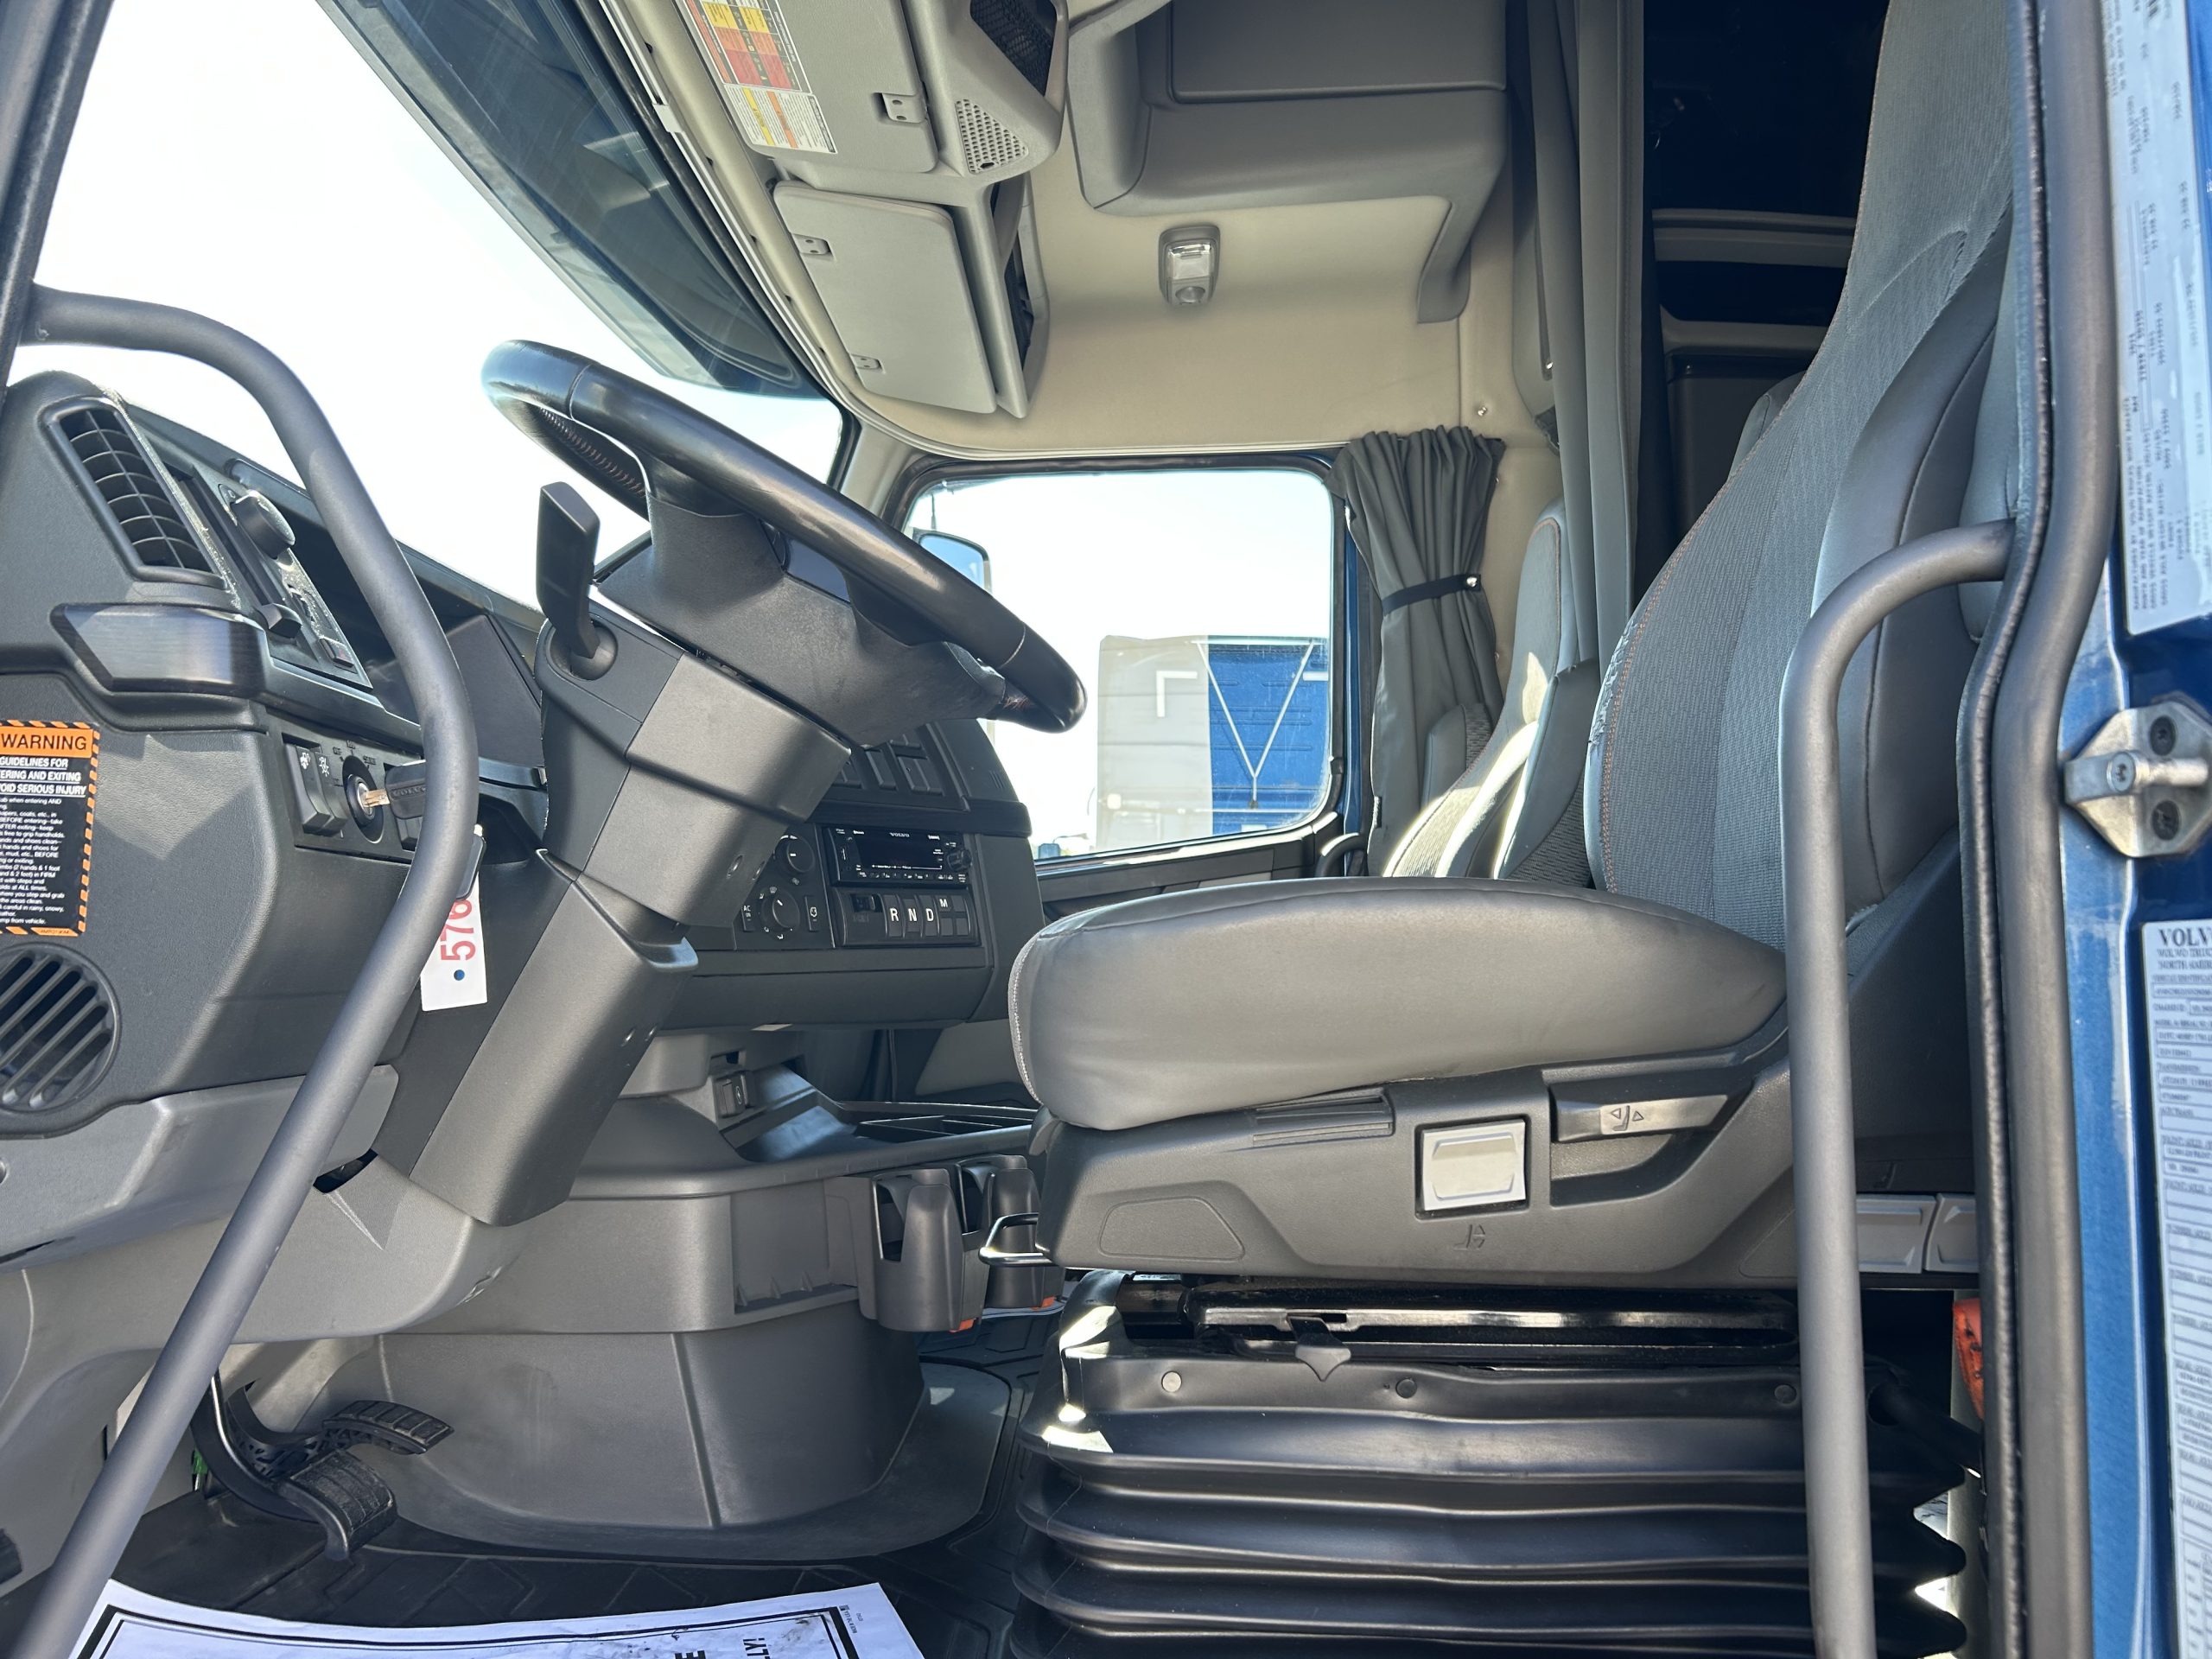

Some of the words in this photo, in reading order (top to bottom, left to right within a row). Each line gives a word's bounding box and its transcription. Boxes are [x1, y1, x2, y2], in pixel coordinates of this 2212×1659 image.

[1, 733, 86, 750] WARNING
[0, 756, 49, 767] GUIDELINES
[50, 758, 68, 767] FOR
[28, 771, 47, 780] AND
[48, 772, 81, 781] EXITING
[17, 784, 54, 793] SERIOUS
[55, 785, 86, 795] INJURY
[890, 908, 899, 922] R
[908, 909, 918, 922] N
[926, 909, 934, 922] D
[939, 899, 949, 907] M
[2159, 927, 2212, 946] VOLV
[743, 1637, 772, 1659] LY!
